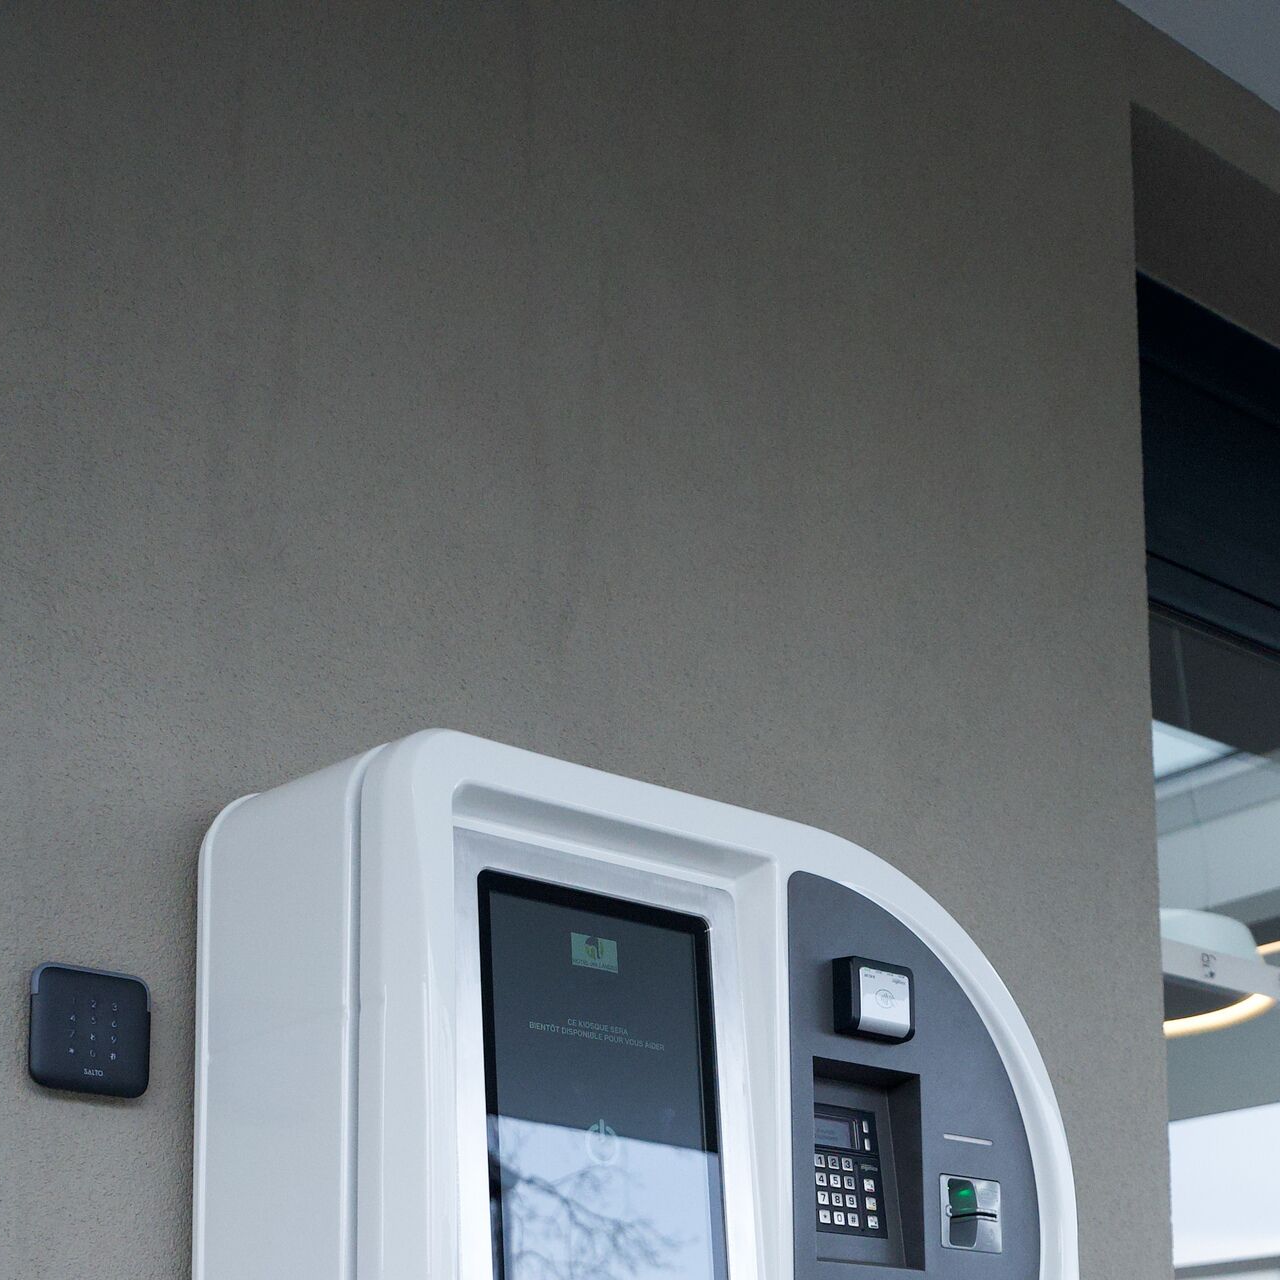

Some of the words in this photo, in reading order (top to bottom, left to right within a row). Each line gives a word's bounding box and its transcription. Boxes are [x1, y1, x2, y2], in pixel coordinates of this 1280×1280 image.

[567, 1018, 577, 1026] CE
[578, 1020, 609, 1031] KIOSQUE
[603, 1034, 624, 1044] POUR
[624, 1037, 644, 1047] VOUS
[83, 1068, 104, 1077] SALTO
[818, 1156, 823, 1165] 1
[831, 1158, 837, 1167] 2
[845, 1160, 851, 1168] 3
[819, 1175, 824, 1184] 4
[833, 1176, 839, 1185] 5
[847, 1178, 853, 1187] 6
[821, 1193, 826, 1202] 7
[834, 1195, 841, 1204] 8
[848, 1196, 854, 1205] 9
[837, 1213, 842, 1222] 0
